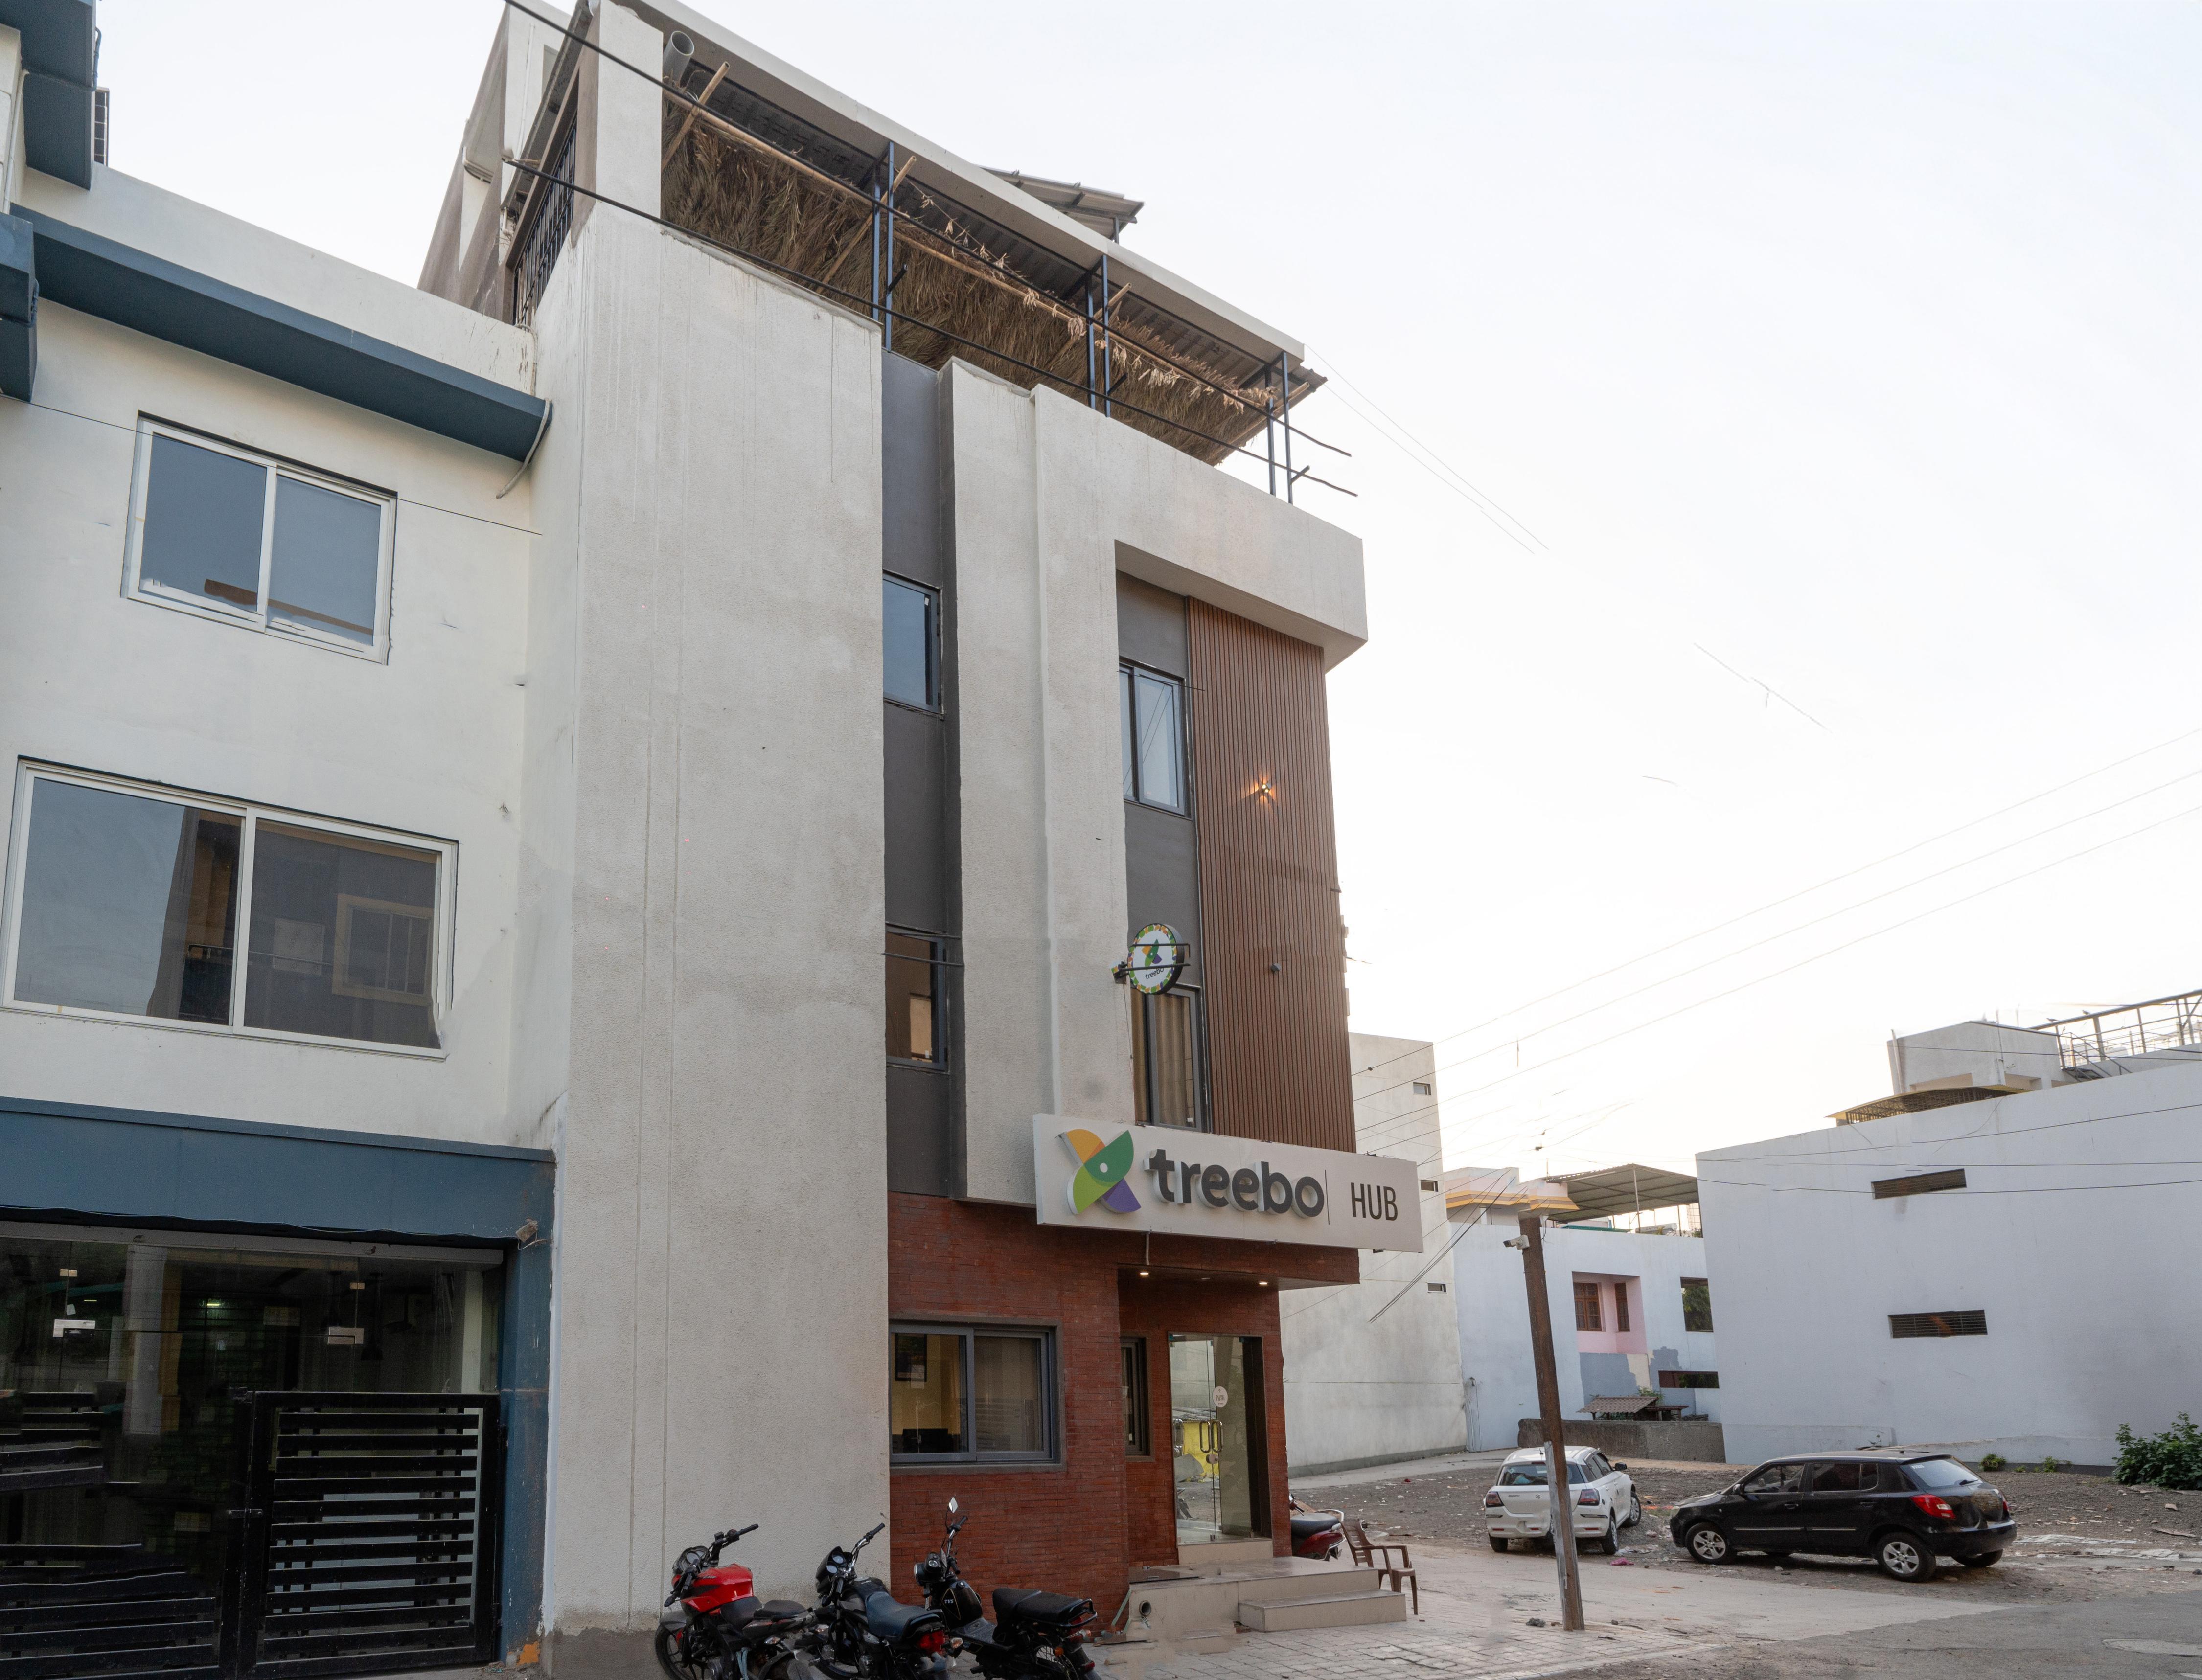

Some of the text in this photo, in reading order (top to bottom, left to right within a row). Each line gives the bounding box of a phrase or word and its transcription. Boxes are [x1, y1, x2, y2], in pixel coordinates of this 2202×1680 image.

[1145, 967, 1164, 979] treebo
[1144, 1148, 1398, 1221] treebo HUB
